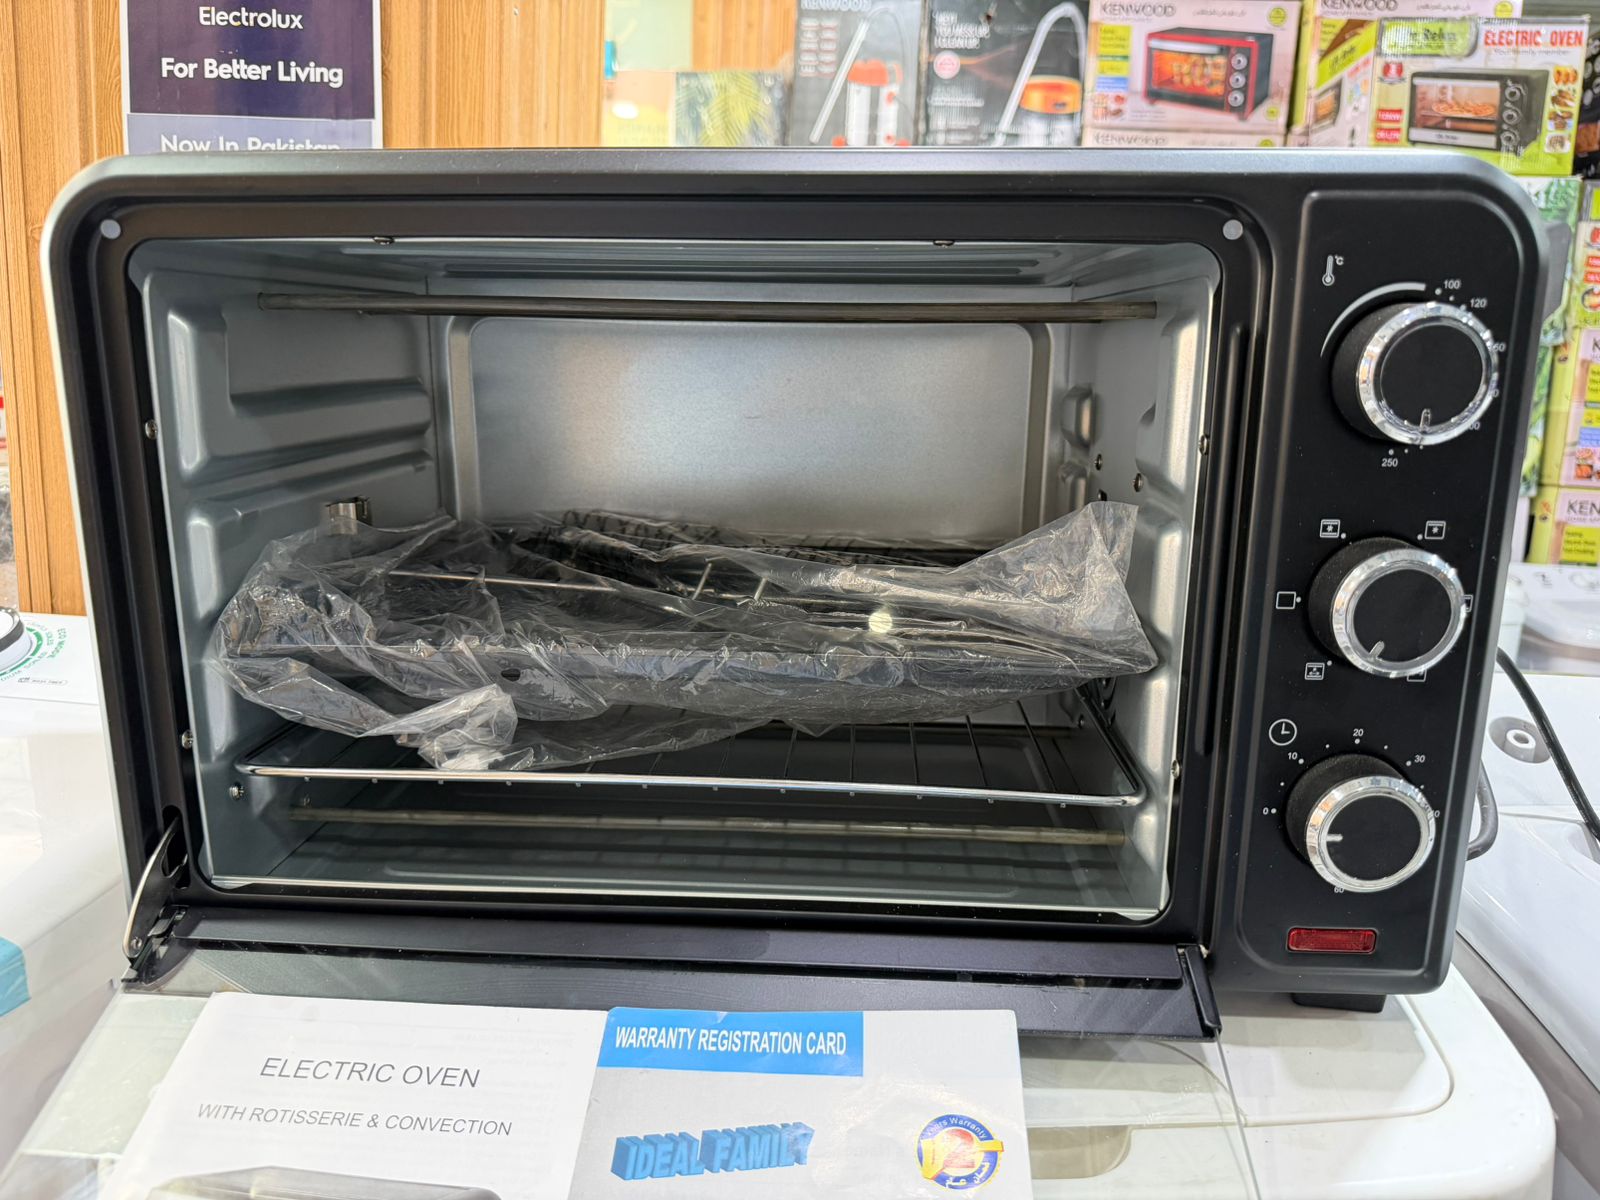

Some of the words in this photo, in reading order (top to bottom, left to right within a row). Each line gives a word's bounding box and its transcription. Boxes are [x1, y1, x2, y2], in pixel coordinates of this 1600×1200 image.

[1101, 2, 1177, 17] KENWOOD
[1321, 0, 1398, 11] KENWOOD
[199, 6, 303, 30] Electrolux
[1484, 31, 1541, 47] ELECTRIC
[1550, 31, 1583, 47] OVEN
[161, 58, 197, 78] For
[204, 58, 271, 81] Better
[278, 61, 344, 88] Living
[161, 134, 211, 151] Now
[219, 136, 237, 151] In
[1443, 279, 1461, 290] 100
[1470, 298, 1487, 309] 120
[1382, 458, 1398, 468] 250
[1353, 728, 1364, 737] 20
[1287, 753, 1298, 761] 10
[1415, 754, 1426, 763] 30
[1262, 807, 1269, 815] 0
[615, 1025, 697, 1049] WARRANTY
[698, 1028, 802, 1054] REGISTRATION
[806, 1031, 847, 1056] CARD
[259, 1056, 396, 1083] ELECTRIC
[402, 1065, 480, 1088] OVEN
[198, 1103, 247, 1121] WITH
[249, 1106, 364, 1127] ROTISSERIE
[367, 1114, 380, 1128] &
[385, 1114, 512, 1136] CONVECTION
[949, 1117, 988, 1139] Warranty
[611, 1132, 704, 1180] IDEAL
[700, 1121, 815, 1173] FAMILY
